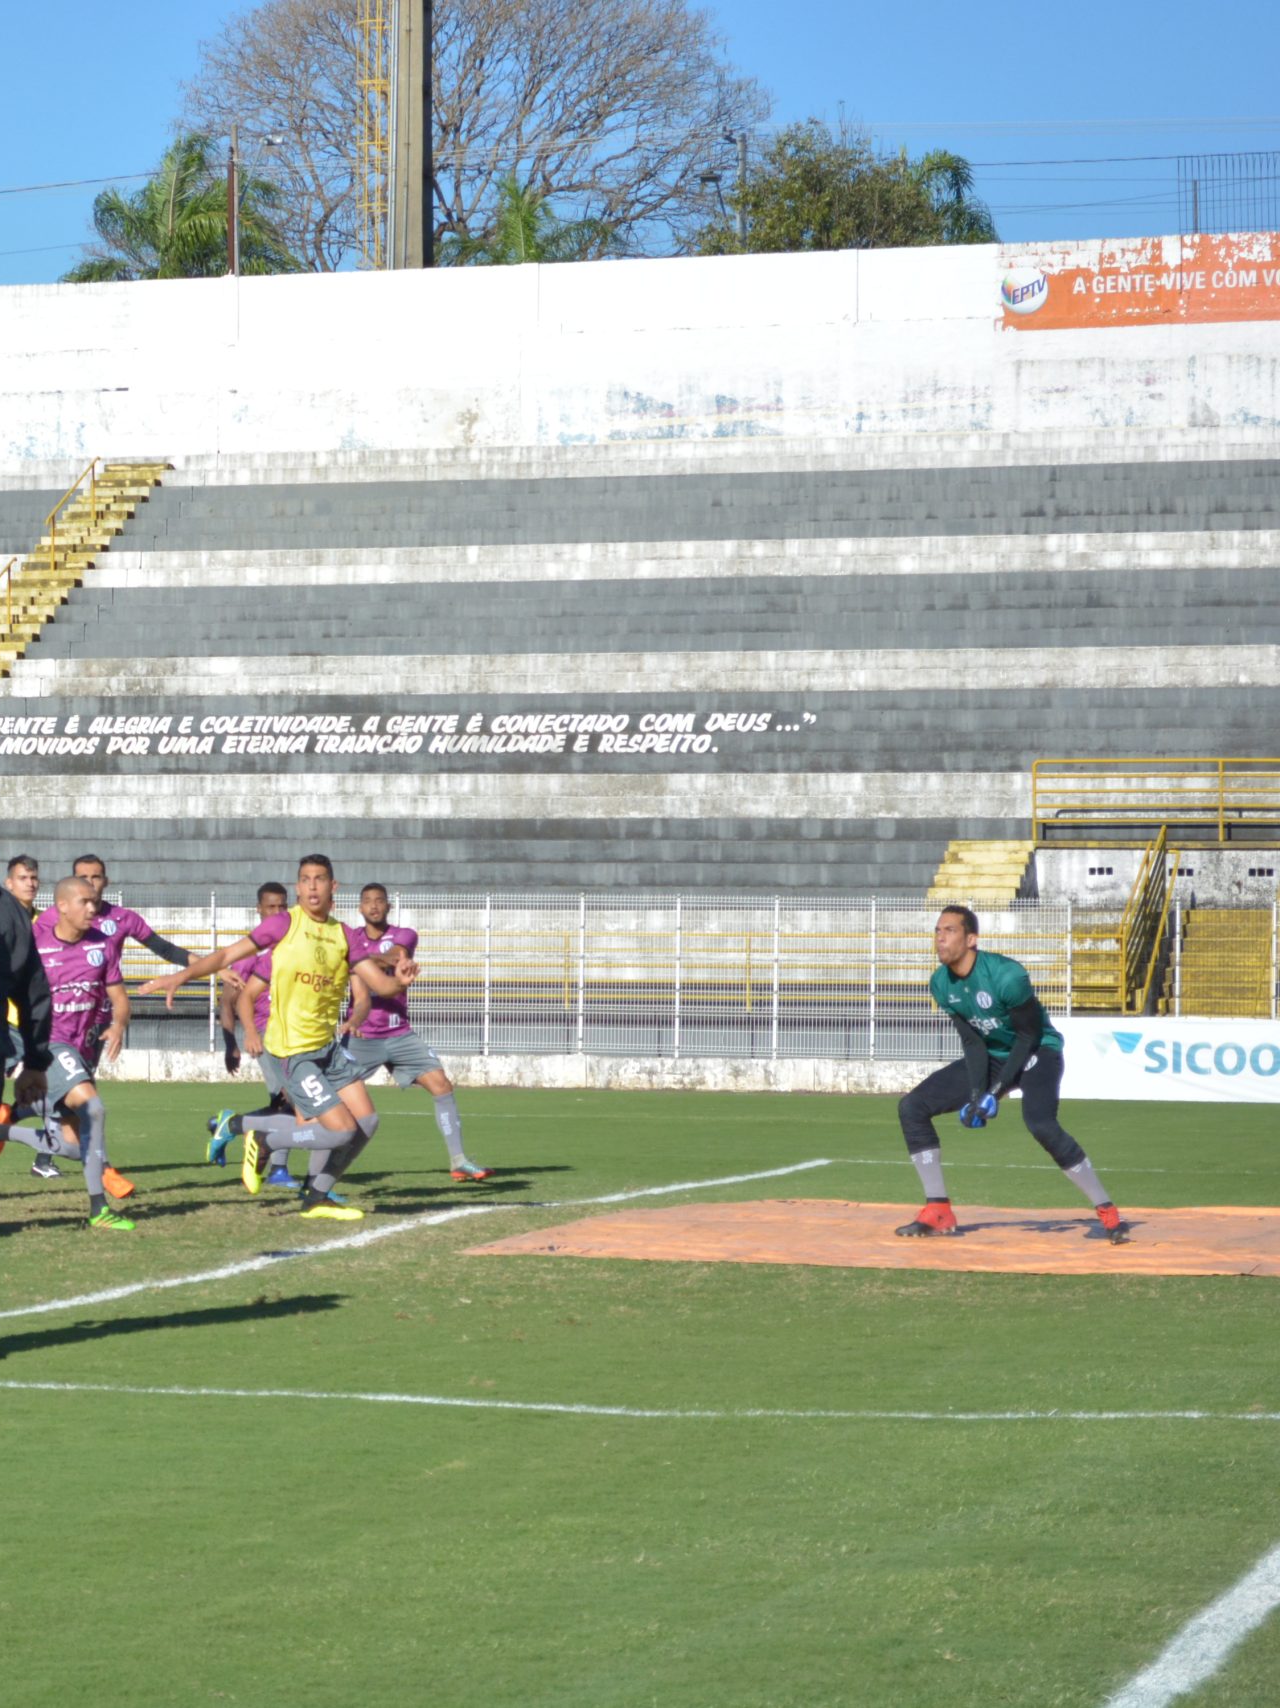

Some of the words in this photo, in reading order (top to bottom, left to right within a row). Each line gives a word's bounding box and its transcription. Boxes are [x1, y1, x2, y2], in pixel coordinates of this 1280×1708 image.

[1011, 274, 1047, 305] EPTV
[1073, 280, 1086, 295] A
[1092, 274, 1155, 293] GENTE
[1164, 271, 1206, 291] VIVE
[1212, 270, 1257, 288] COM
[64, 714, 80, 734] É
[88, 716, 173, 734] ALEGRIA
[178, 716, 194, 733] E
[200, 715, 356, 734] COLETIVIDADE.
[362, 715, 381, 733] A
[386, 715, 459, 734] GENTE
[466, 713, 483, 733] É
[491, 713, 629, 733] CONECTADO
[639, 713, 696, 733] COM
[705, 712, 772, 732] DEUS
[106, 736, 150, 755] POR
[157, 736, 215, 754] UMA
[221, 735, 309, 754] ETERNA
[314, 732, 423, 755] TRADIÇÃO
[428, 734, 566, 754] HUMILDADE
[573, 734, 589, 753] E
[598, 734, 718, 753] RESPEITO.
[57, 1051, 77, 1071] 6
[301, 1074, 324, 1098] 15
